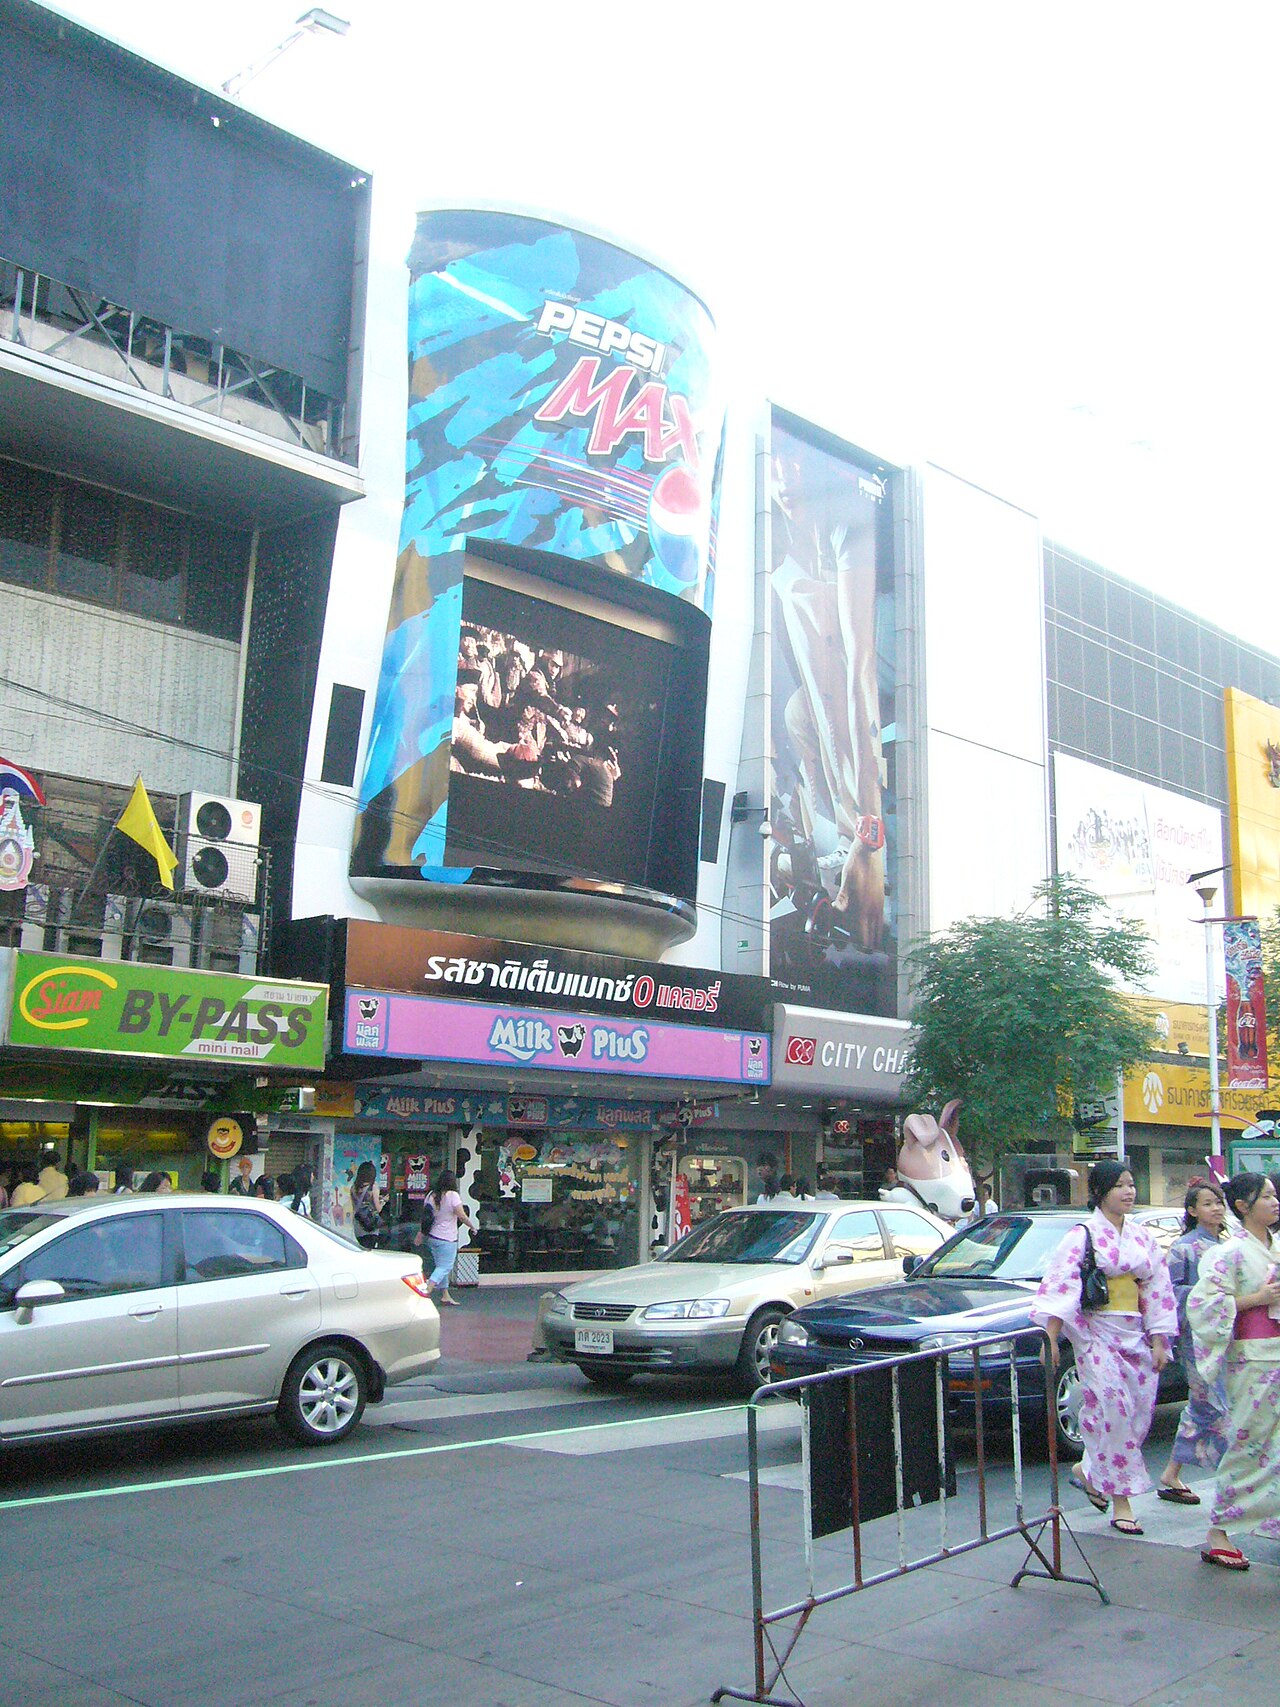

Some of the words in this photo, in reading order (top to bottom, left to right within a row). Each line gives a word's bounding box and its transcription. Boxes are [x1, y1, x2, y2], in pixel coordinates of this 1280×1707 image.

[536, 299, 667, 377] PEPSI
[535, 356, 699, 467] MAX
[30, 980, 103, 1020] Siam
[655, 980, 722, 1013] แคลอรี่
[117, 988, 313, 1049] BY-PASS
[197, 1042, 229, 1055] mini
[230, 1044, 259, 1057] mall
[489, 1018, 553, 1061] Milk
[821, 1040, 867, 1070] CITY
[591, 1332, 610, 1344] 2023
